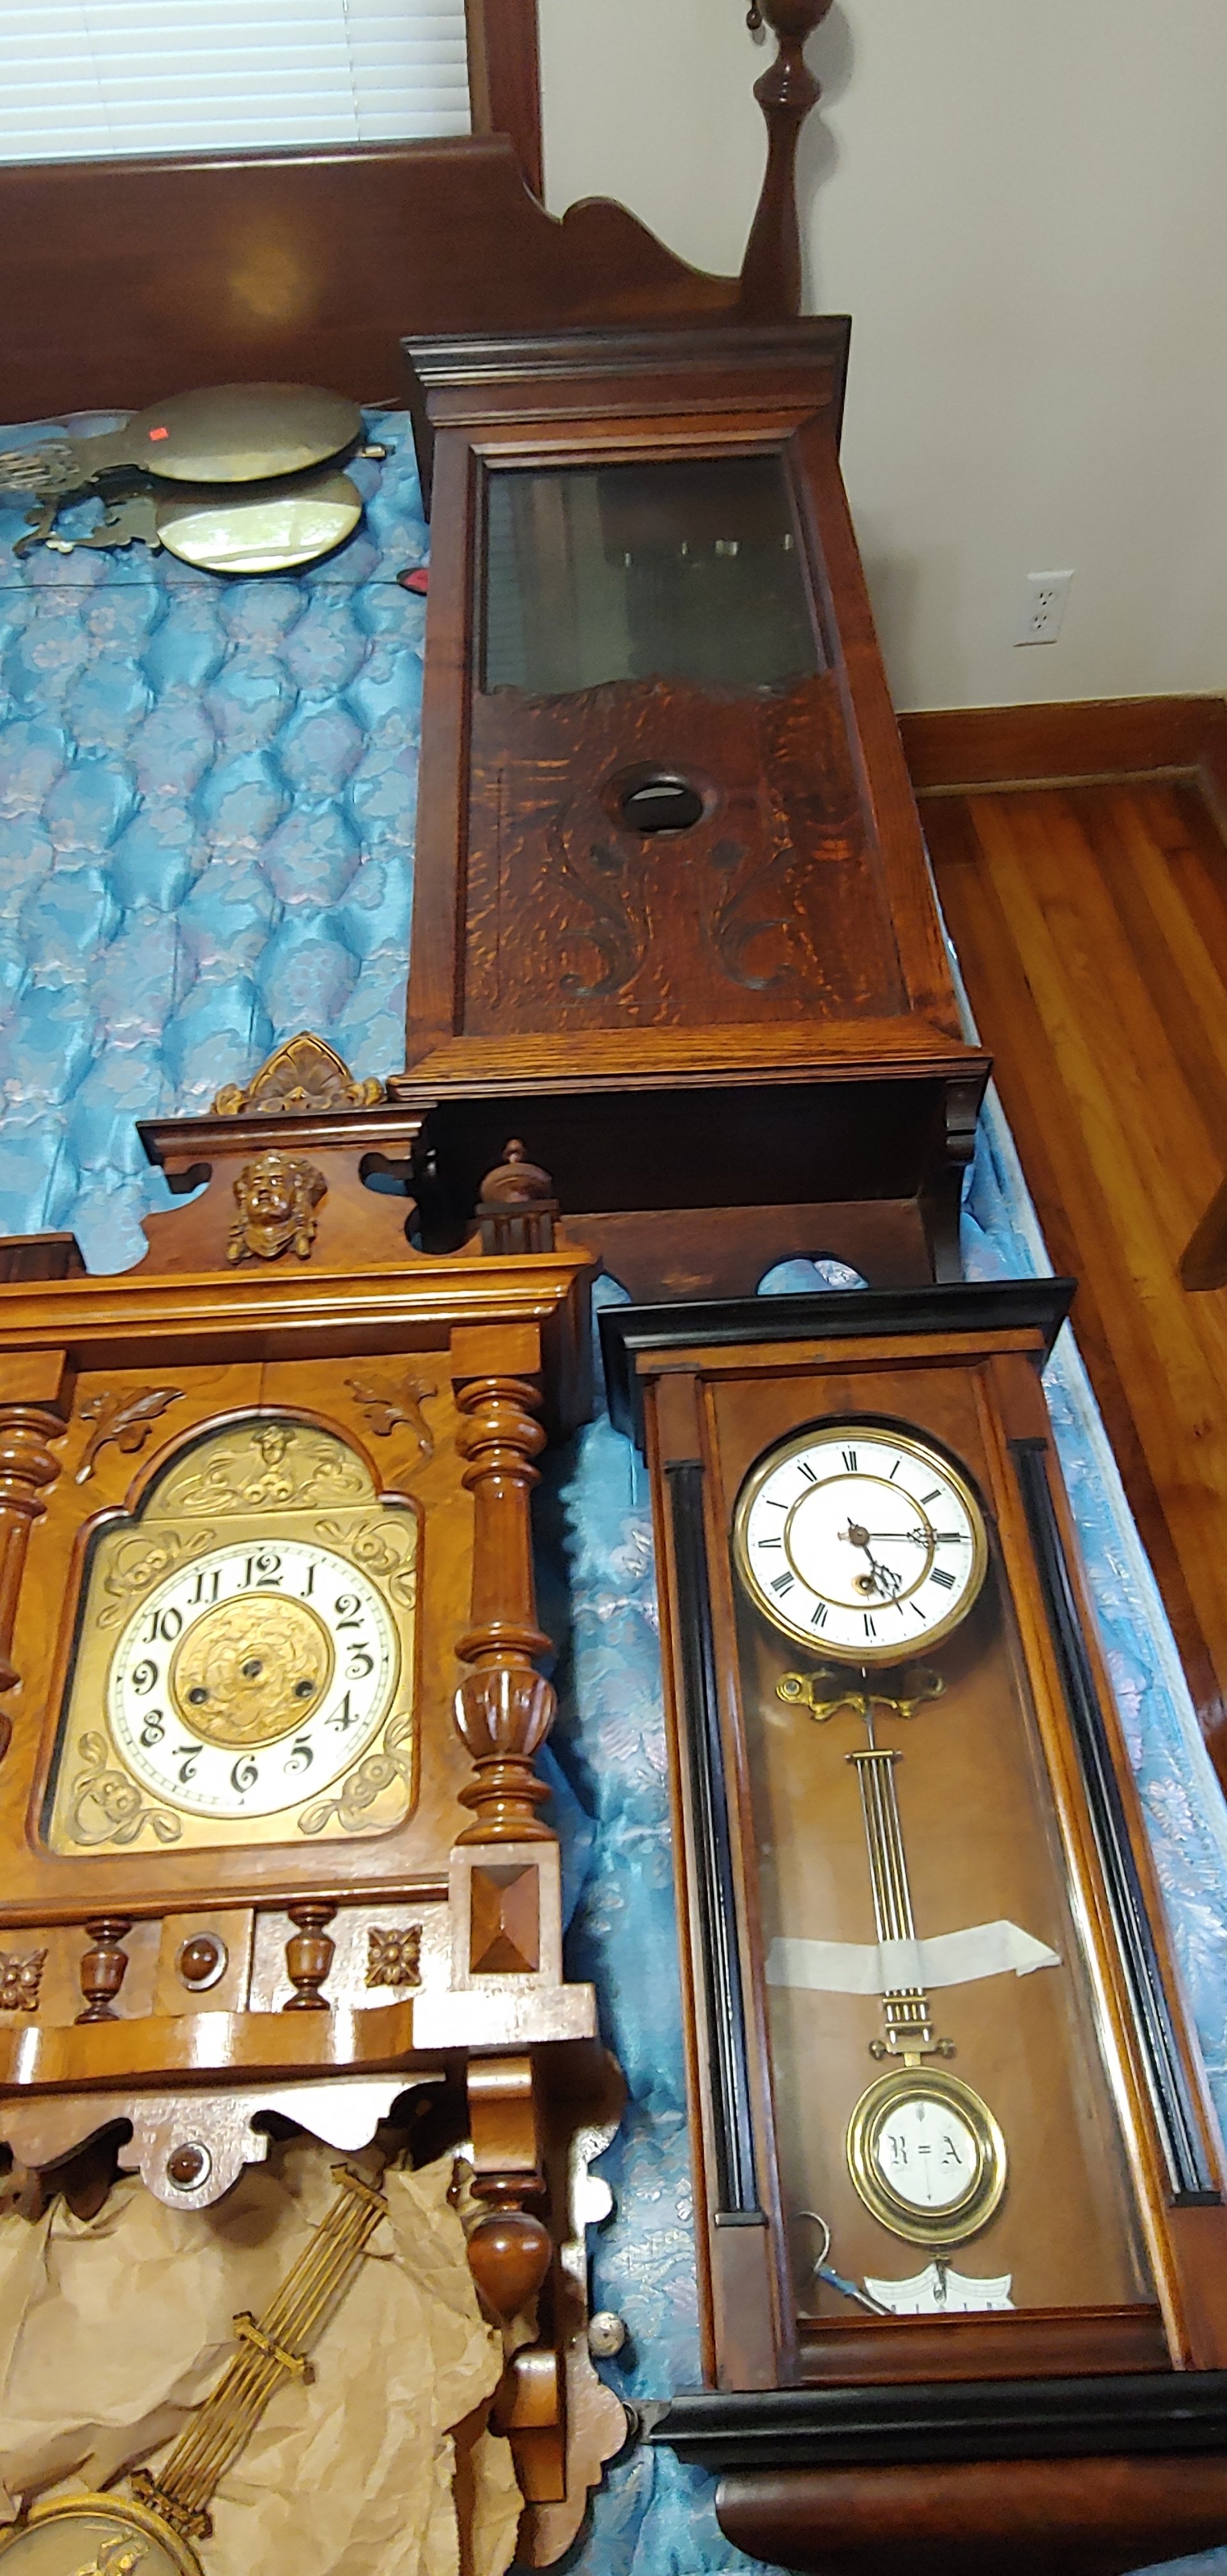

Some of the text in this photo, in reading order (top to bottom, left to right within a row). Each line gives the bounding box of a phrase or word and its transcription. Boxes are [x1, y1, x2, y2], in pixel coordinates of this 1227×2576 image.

[187, 1569, 223, 1604] 11
[236, 1555, 284, 1589] 12
[300, 1563, 318, 1598] 1
[142, 1606, 183, 1643] 10
[334, 1594, 365, 1631] 2
[132, 1659, 158, 1695] 9
[344, 1642, 374, 1680] 3
[139, 1709, 166, 1747] 8
[325, 1689, 360, 1732] 4
[172, 1745, 204, 1783] 7
[283, 1734, 314, 1775] 5
[231, 1754, 258, 1793] 6
